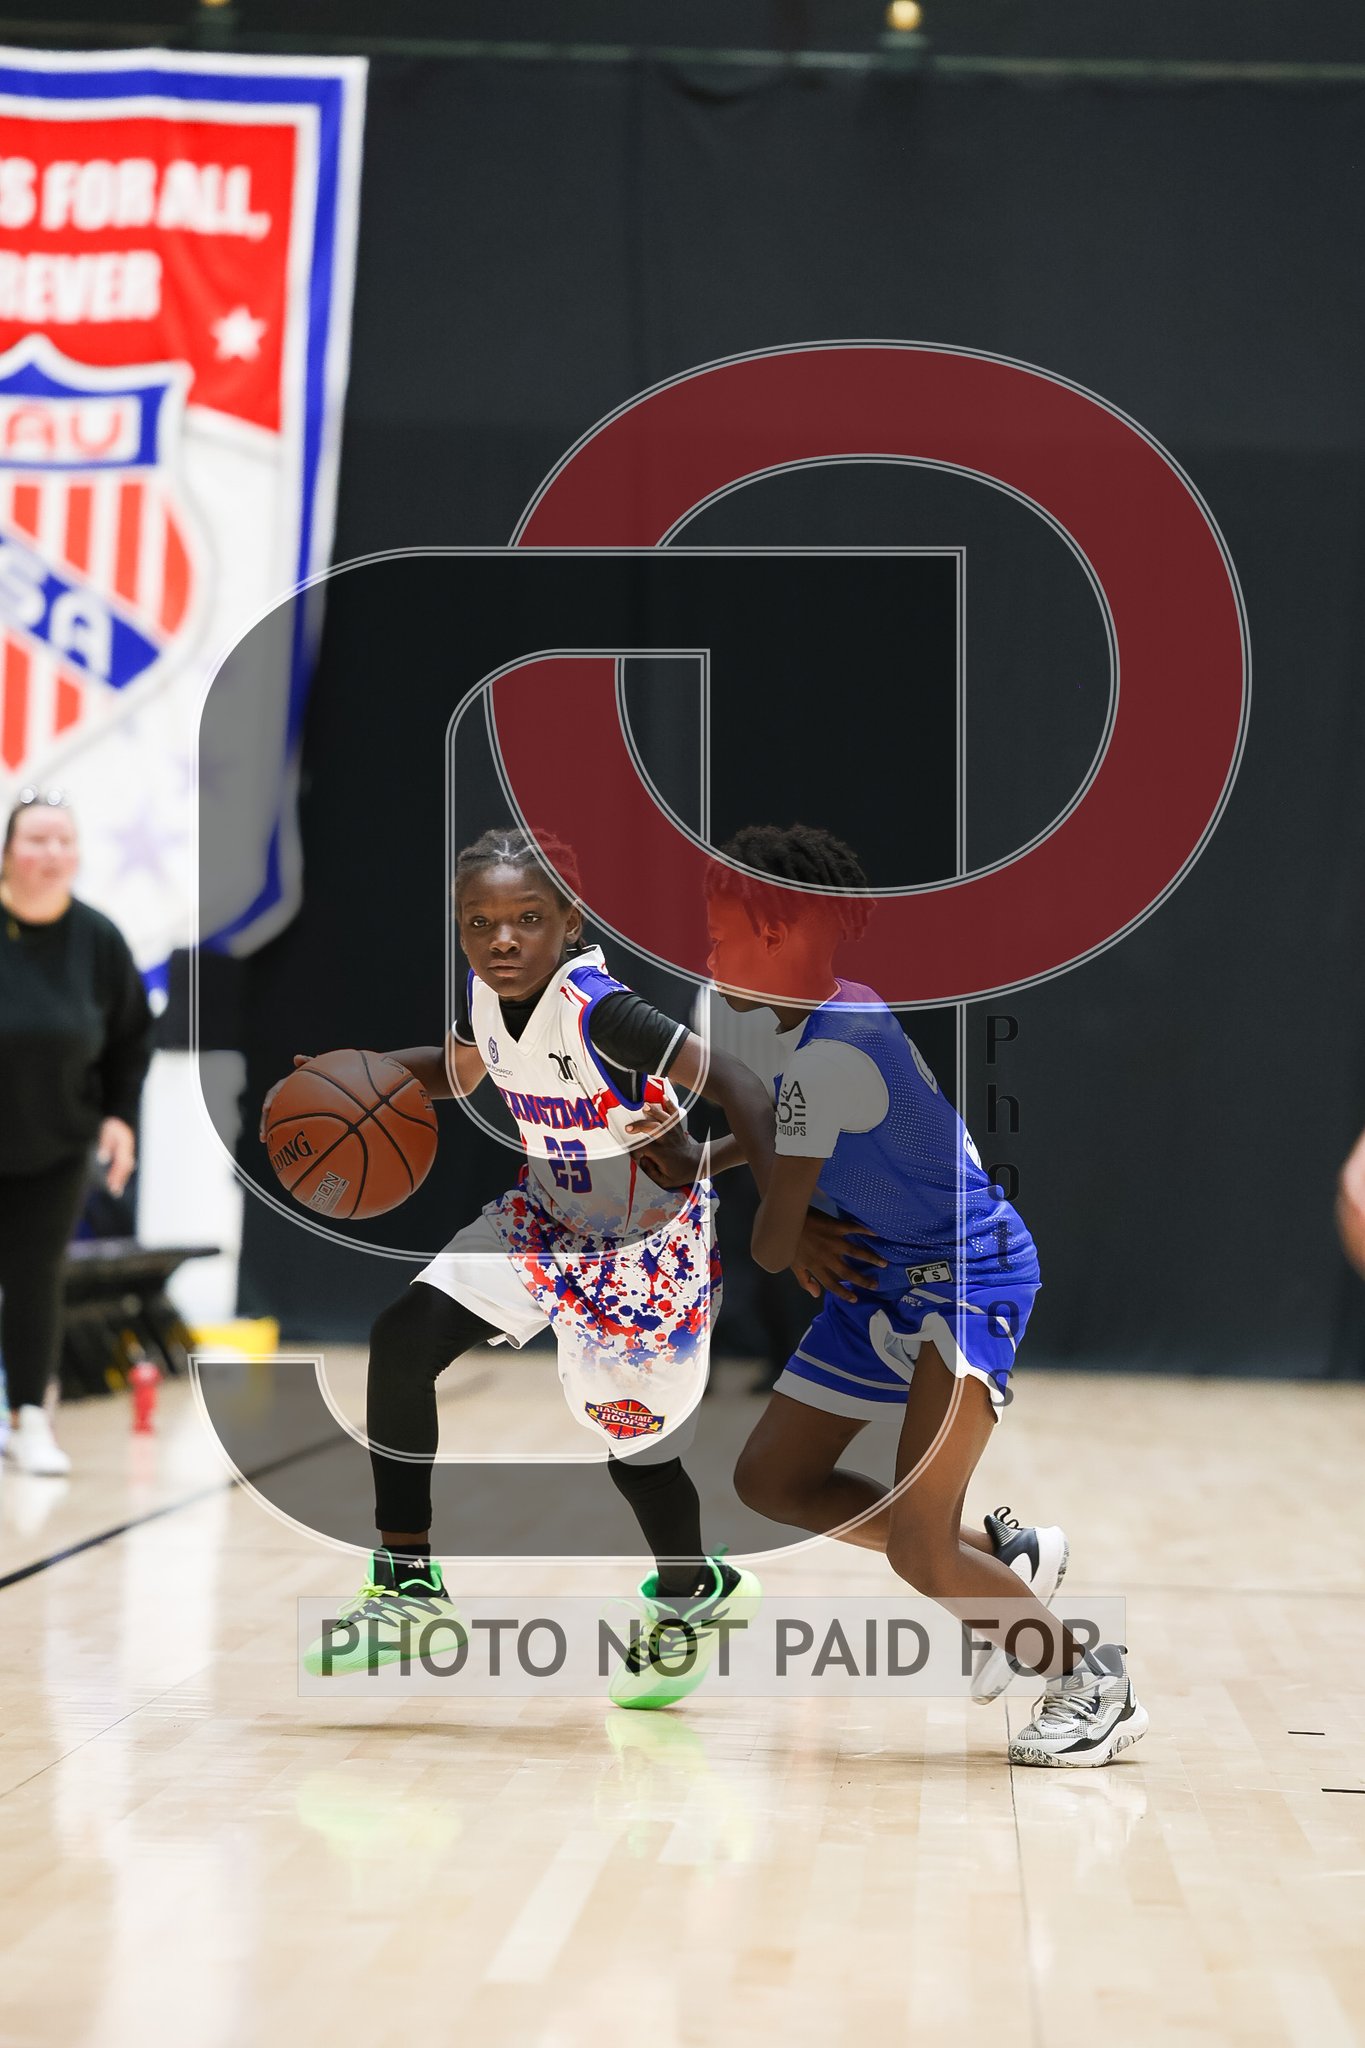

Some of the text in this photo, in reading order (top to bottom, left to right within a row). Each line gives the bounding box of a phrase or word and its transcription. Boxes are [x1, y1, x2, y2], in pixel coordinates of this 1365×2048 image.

[41, 159, 157, 231] FOR
[272, 1131, 313, 1172] DING
[543, 1135, 593, 1194] 23
[931, 1270, 941, 1280] S
[595, 1405, 654, 1424] HANG TIME
